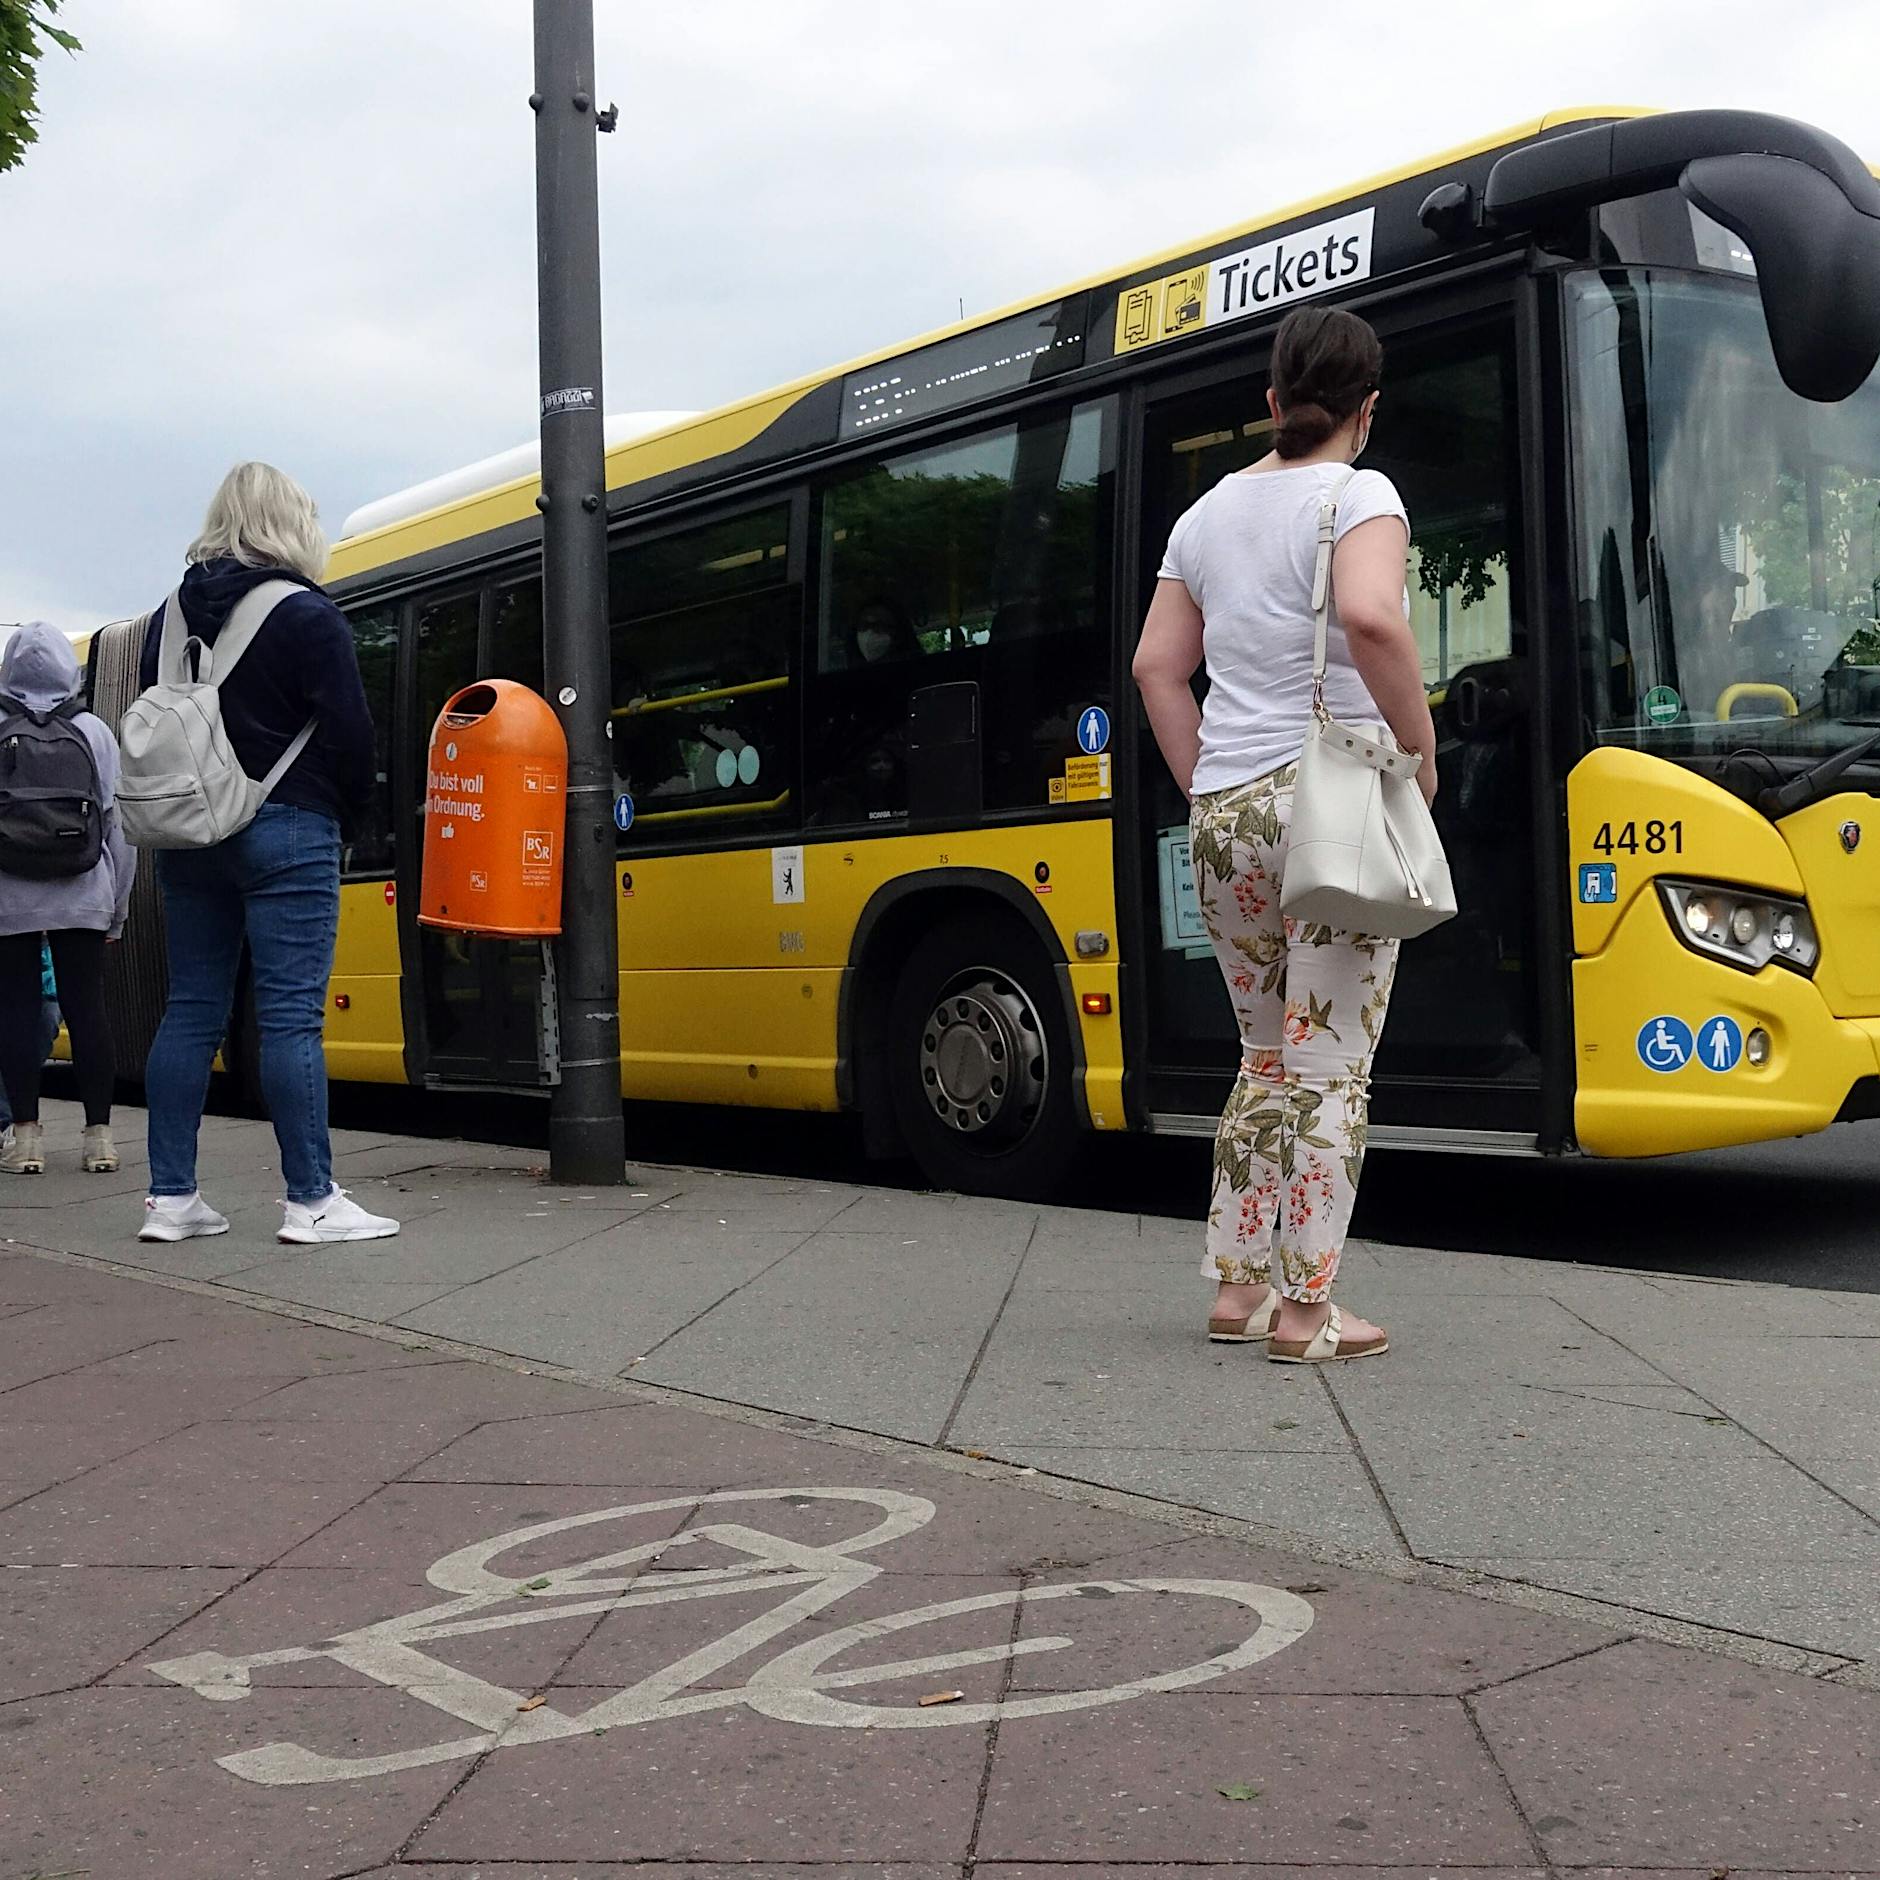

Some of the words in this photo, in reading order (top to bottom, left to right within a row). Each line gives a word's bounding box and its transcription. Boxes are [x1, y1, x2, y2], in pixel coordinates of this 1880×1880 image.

[1218, 233, 1360, 314] Tickets
[440, 771, 459, 792] bist
[460, 774, 484, 794] voll
[433, 794, 486, 822] Ordnung.
[526, 836, 550, 860] BSR
[1592, 820, 1683, 856] 4481
